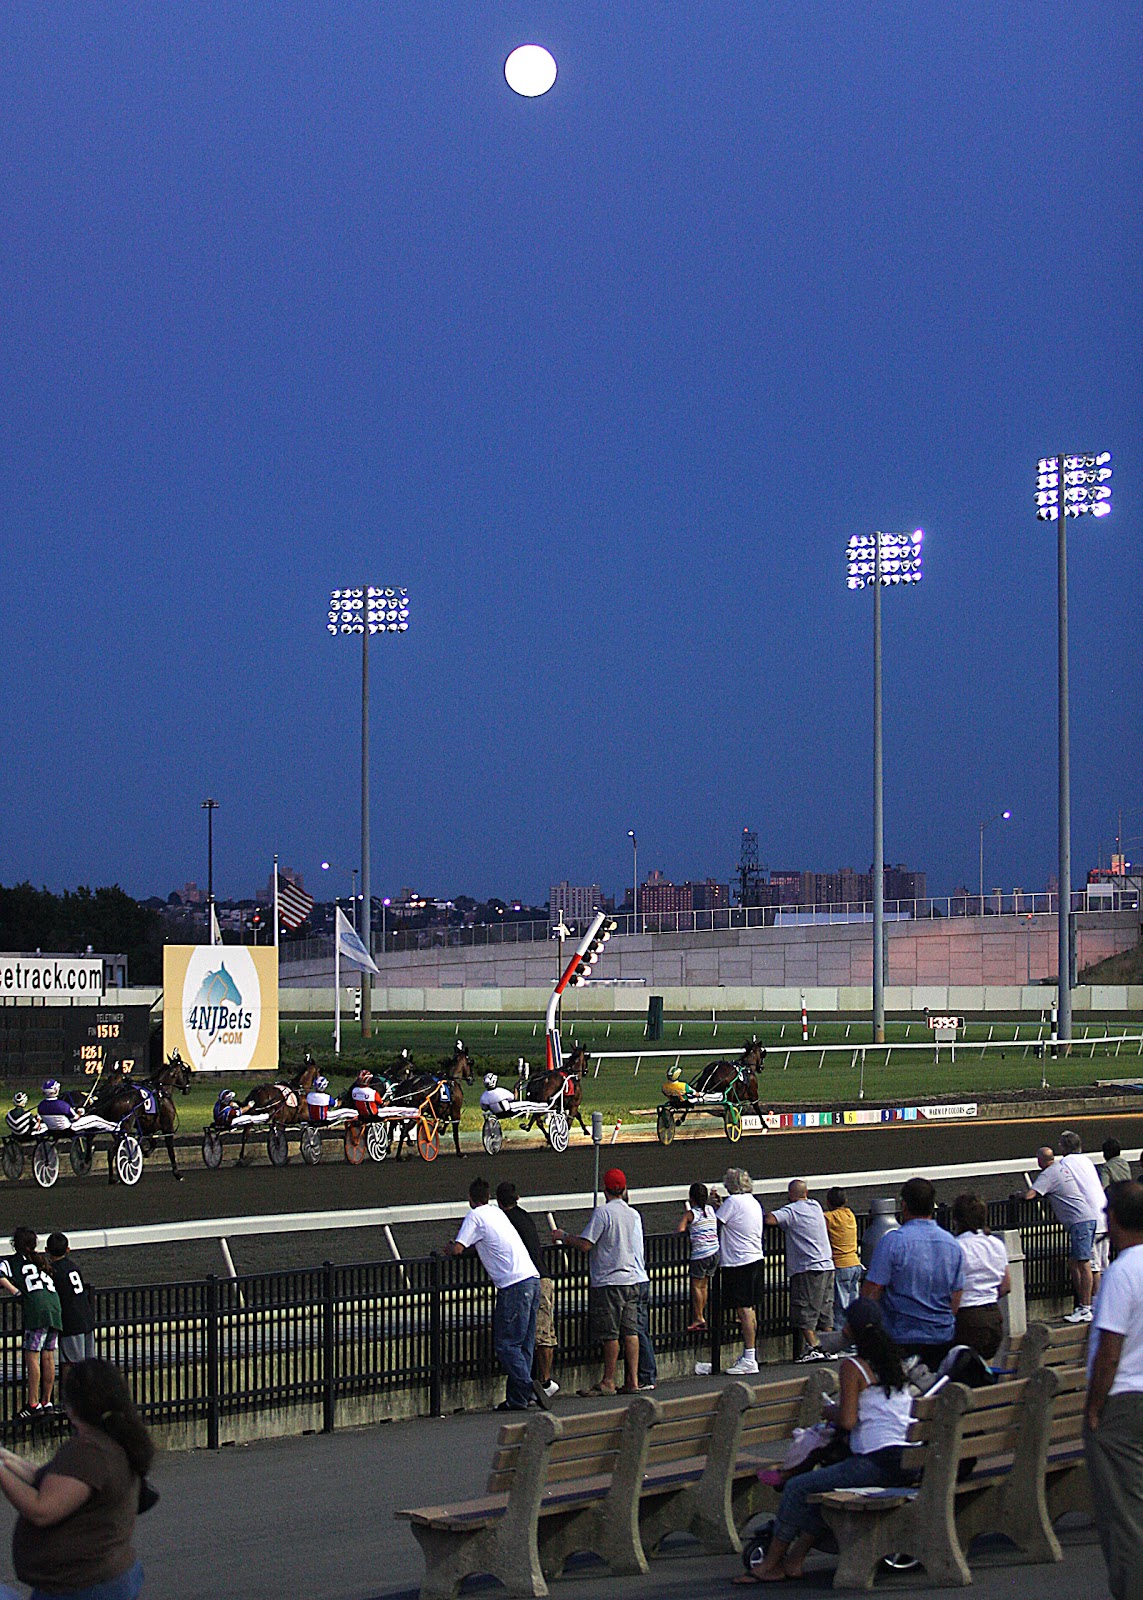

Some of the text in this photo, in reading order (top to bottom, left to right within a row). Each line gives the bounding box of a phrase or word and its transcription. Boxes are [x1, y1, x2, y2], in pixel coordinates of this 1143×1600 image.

[0, 962, 102, 989] etrack.com
[189, 1006, 252, 1036] 4NJBets
[97, 1024, 120, 1039] 1513
[784, 1114, 789, 1126] 1
[797, 1113, 802, 1125] 2
[810, 1114, 815, 1124] 3
[836, 1112, 841, 1124] 5
[848, 1112, 853, 1122] 6
[885, 1109, 890, 1121] 9
[68, 1270, 84, 1294] 9
